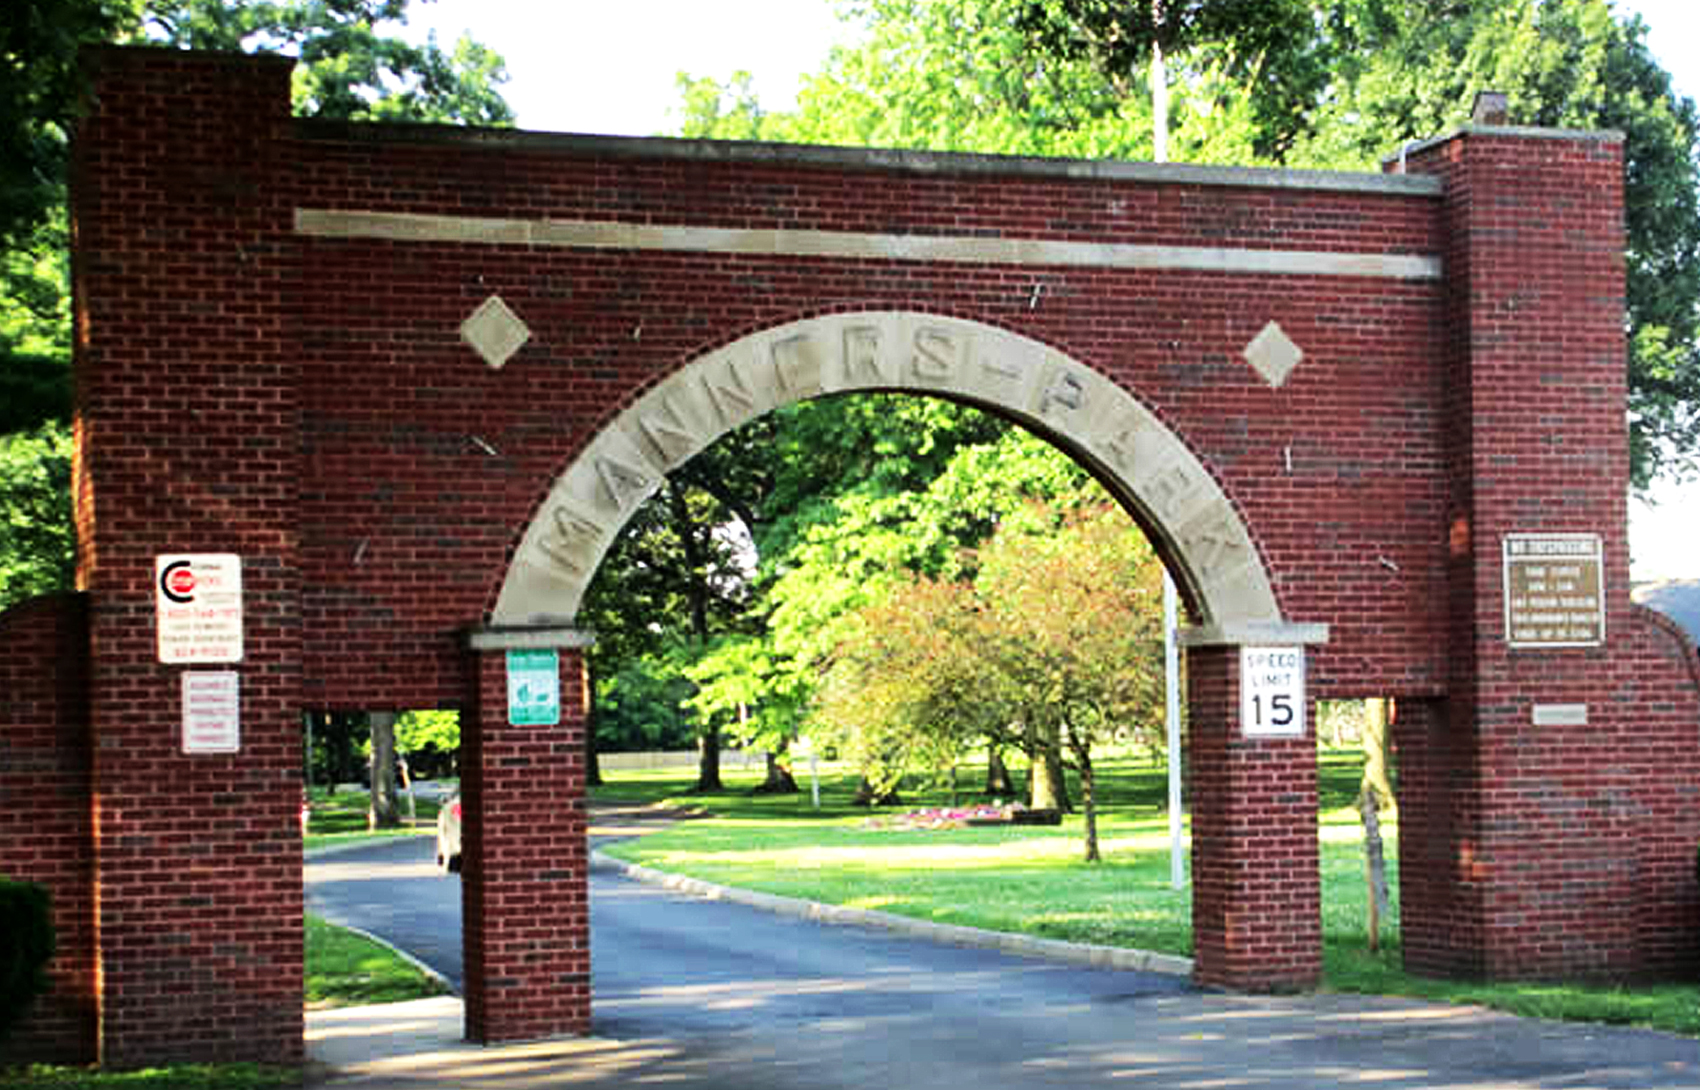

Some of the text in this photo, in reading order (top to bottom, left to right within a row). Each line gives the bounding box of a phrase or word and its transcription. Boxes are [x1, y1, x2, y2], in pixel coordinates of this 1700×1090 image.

[1247, 653, 1297, 669] SPEED
[1250, 672, 1293, 688] LIMIT
[1251, 694, 1295, 726] 15
